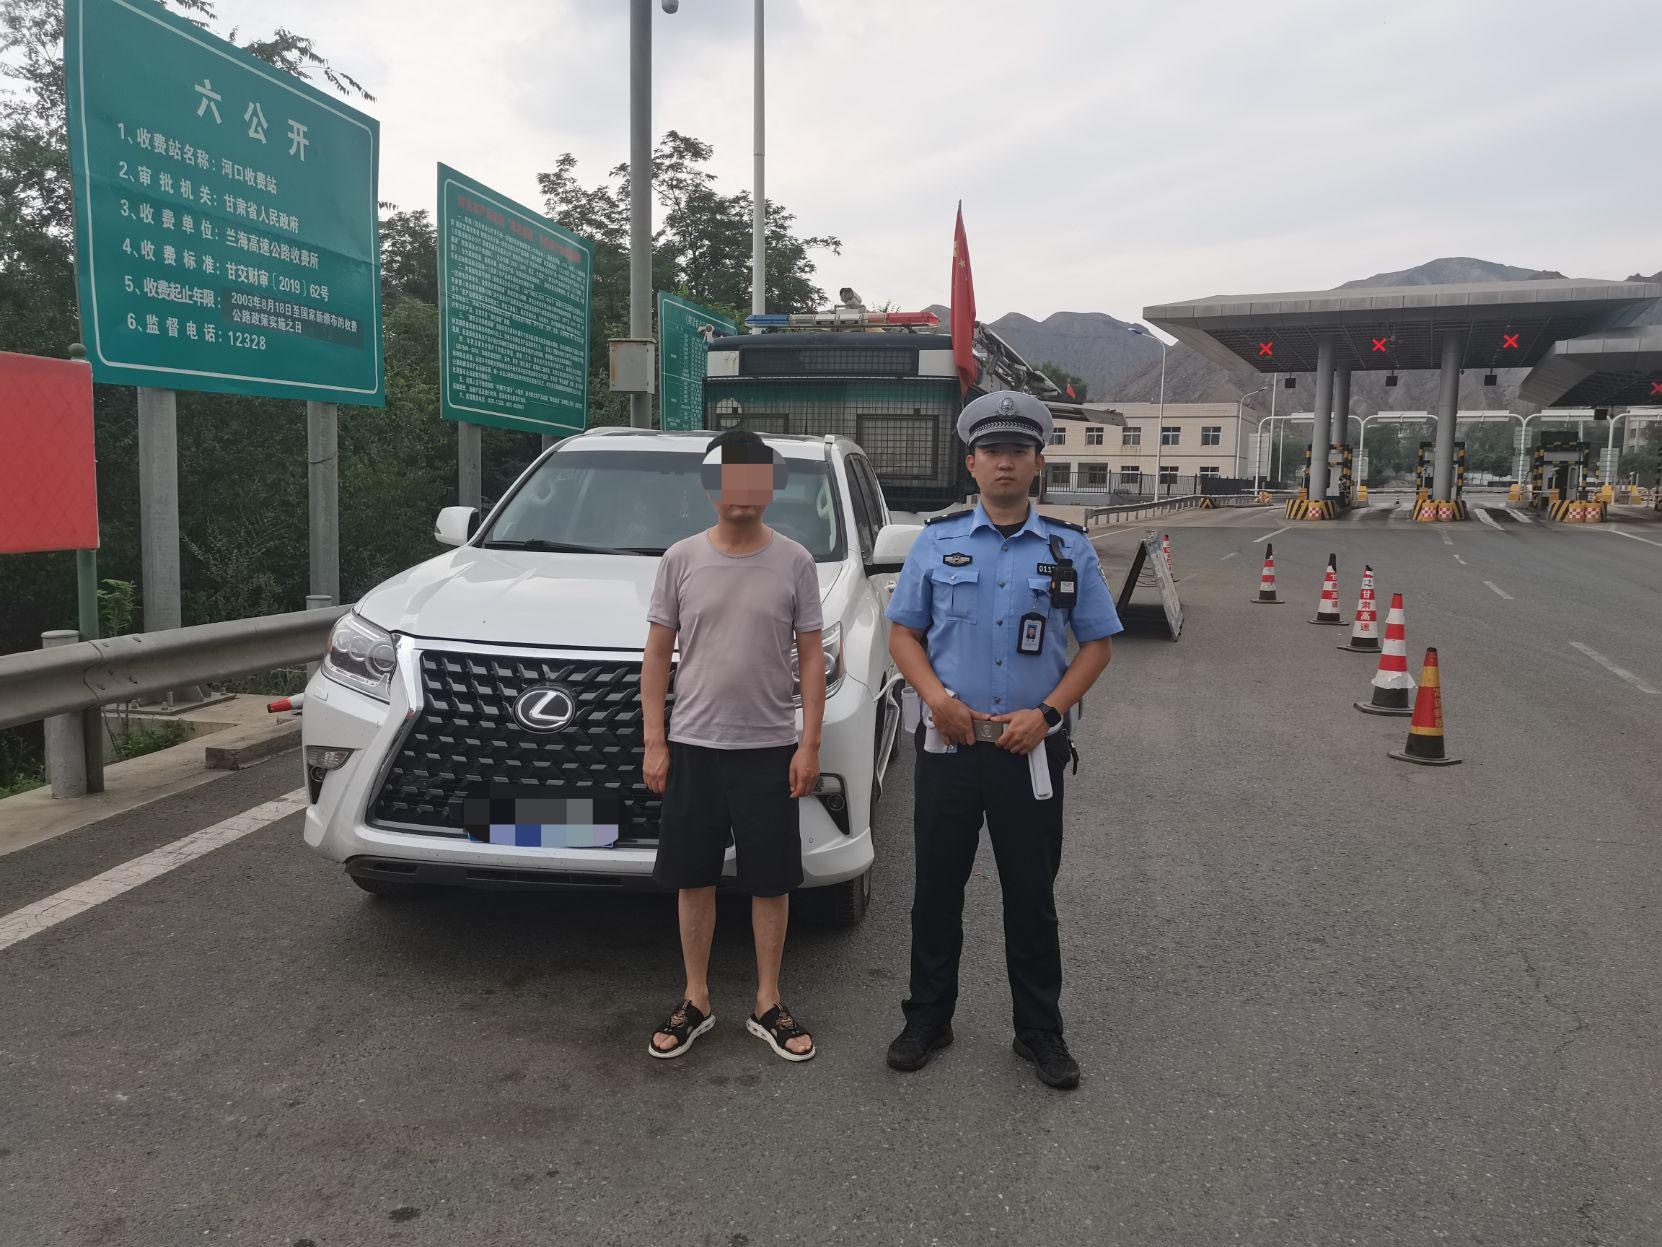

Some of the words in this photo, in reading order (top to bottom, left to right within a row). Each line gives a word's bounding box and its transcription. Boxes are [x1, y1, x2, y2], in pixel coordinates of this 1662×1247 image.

[194, 79, 310, 162] 六公开
[232, 308, 302, 334] 公路政策实施之日
[1360, 590, 1371, 632] 甘肃高速
